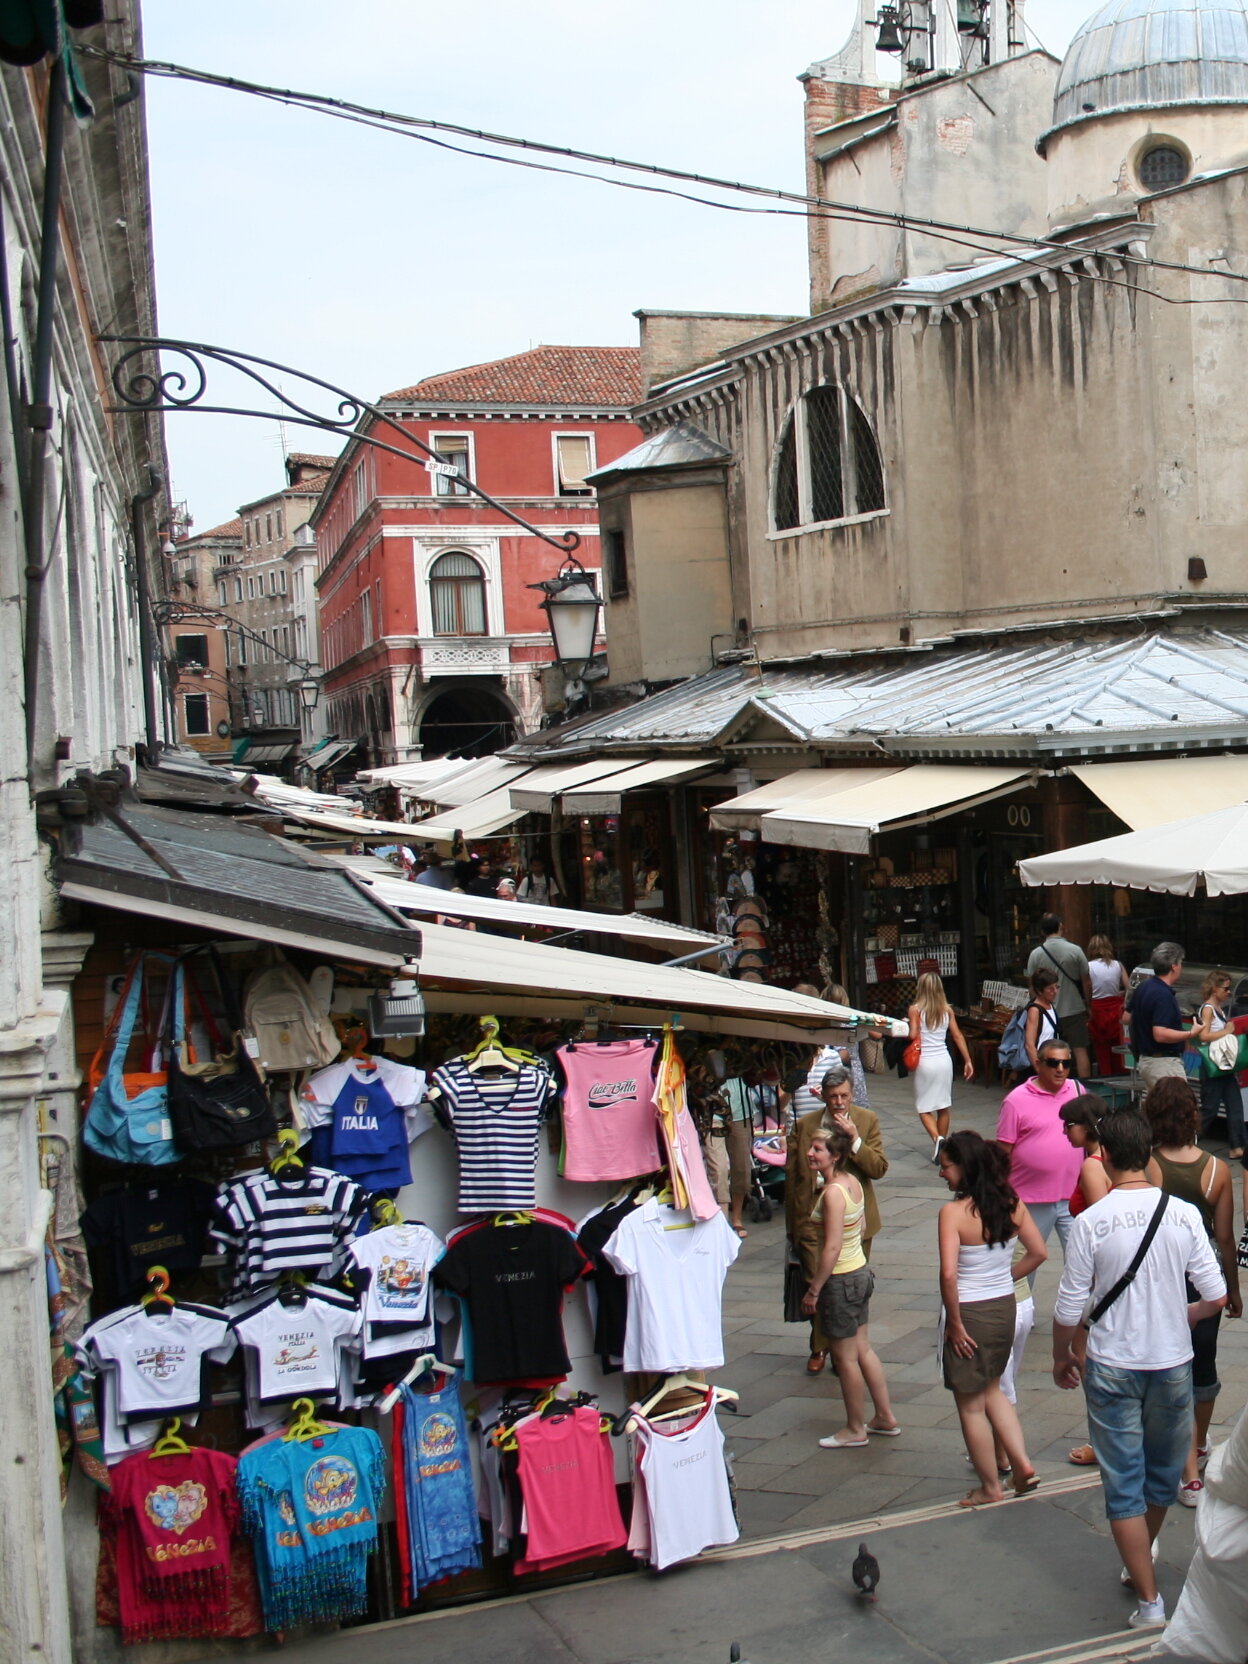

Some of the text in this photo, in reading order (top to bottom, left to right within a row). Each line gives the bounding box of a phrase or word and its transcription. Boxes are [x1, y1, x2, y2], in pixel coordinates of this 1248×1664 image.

[341, 1115, 379, 1131] ITALIA
[1093, 1210, 1193, 1238] GABBNA
[495, 1271, 536, 1283] VENEZIA
[278, 1331, 315, 1341] VENEZIA
[672, 1449, 707, 1469] VENEZIA
